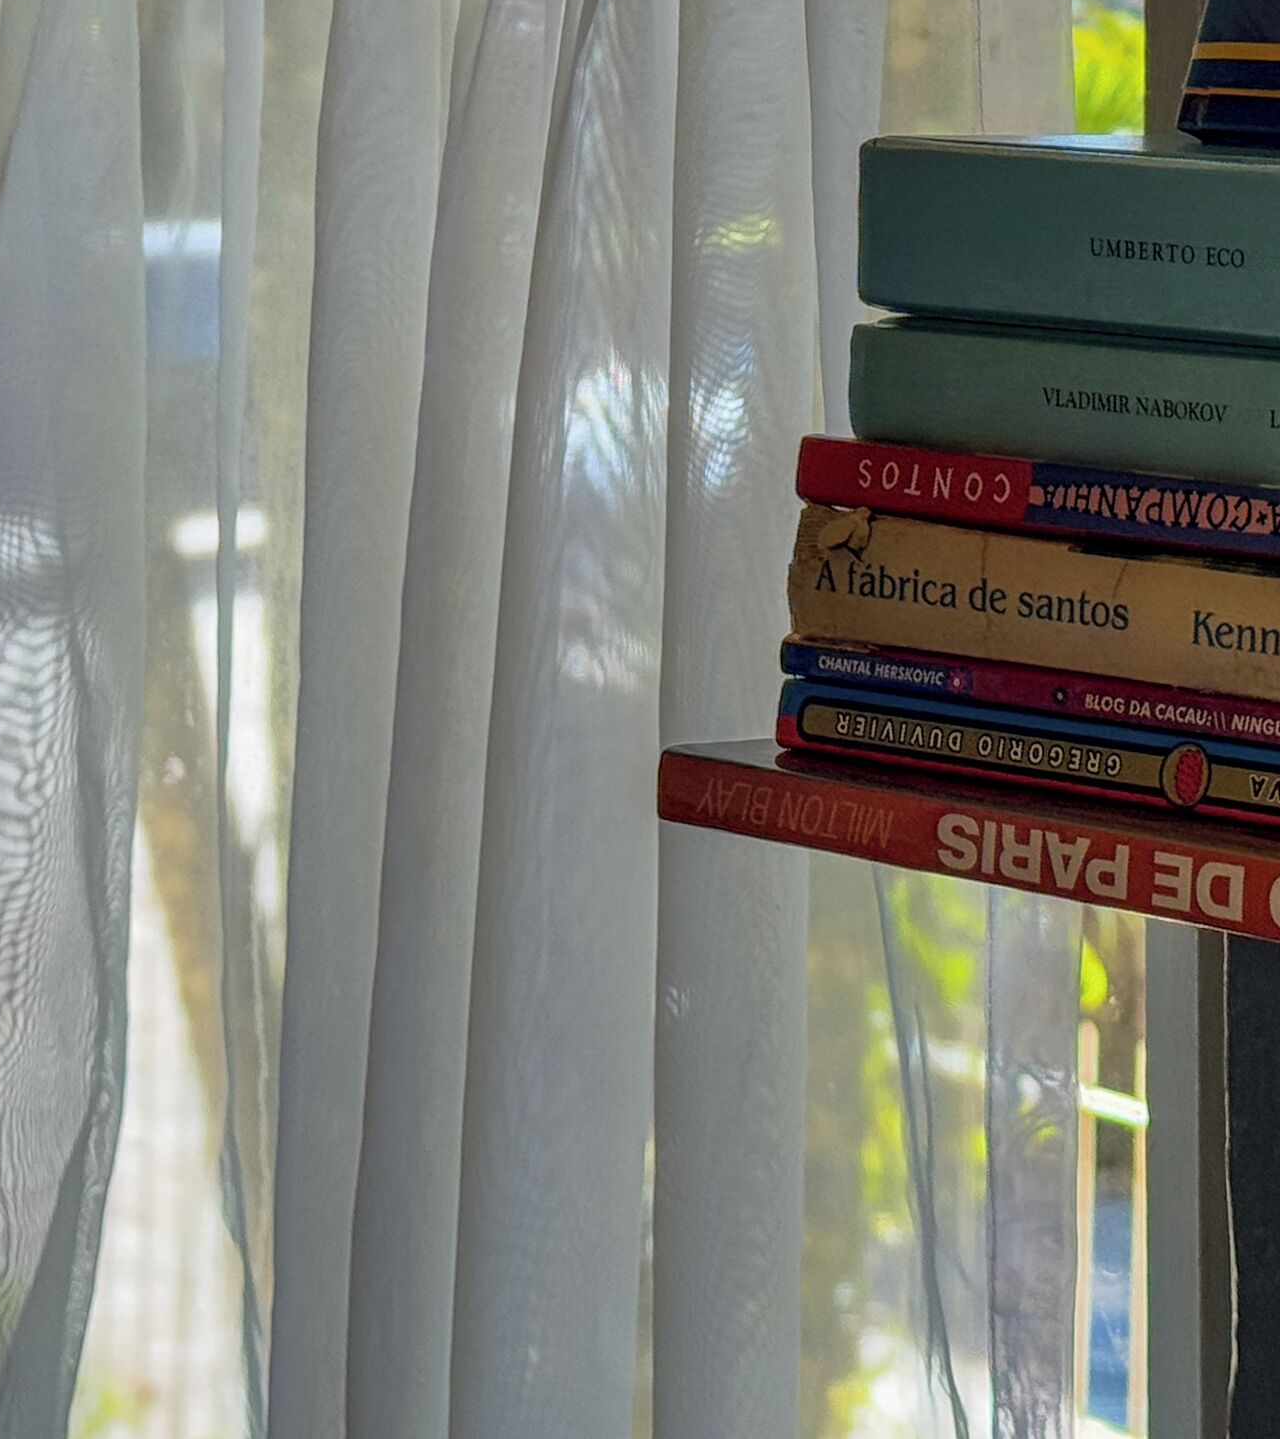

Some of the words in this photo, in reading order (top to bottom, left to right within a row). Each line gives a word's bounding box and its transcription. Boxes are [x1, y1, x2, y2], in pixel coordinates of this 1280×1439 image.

[1089, 236, 1196, 264] UMBERTO
[1205, 246, 1246, 269] ECO
[1042, 387, 1130, 415] VLADIMIR
[1135, 396, 1229, 423] NABOKOV
[858, 458, 1011, 504] CONTOS
[815, 560, 836, 593] A
[848, 557, 958, 609] fábrica
[968, 579, 1007, 616] de
[1019, 591, 1130, 631] santos
[818, 655, 872, 677] CHANTAL
[874, 661, 945, 687] HERSKOVIC
[1085, 693, 1125, 714] BLOG
[1129, 699, 1151, 718] DA
[835, 713, 962, 752] DUVIVIER
[978, 737, 1121, 775] GREGORIO
[697, 778, 767, 826] BLAY
[778, 790, 894, 849] MILTON
[936, 812, 1129, 899] PARIS
[1152, 850, 1245, 922] DE
